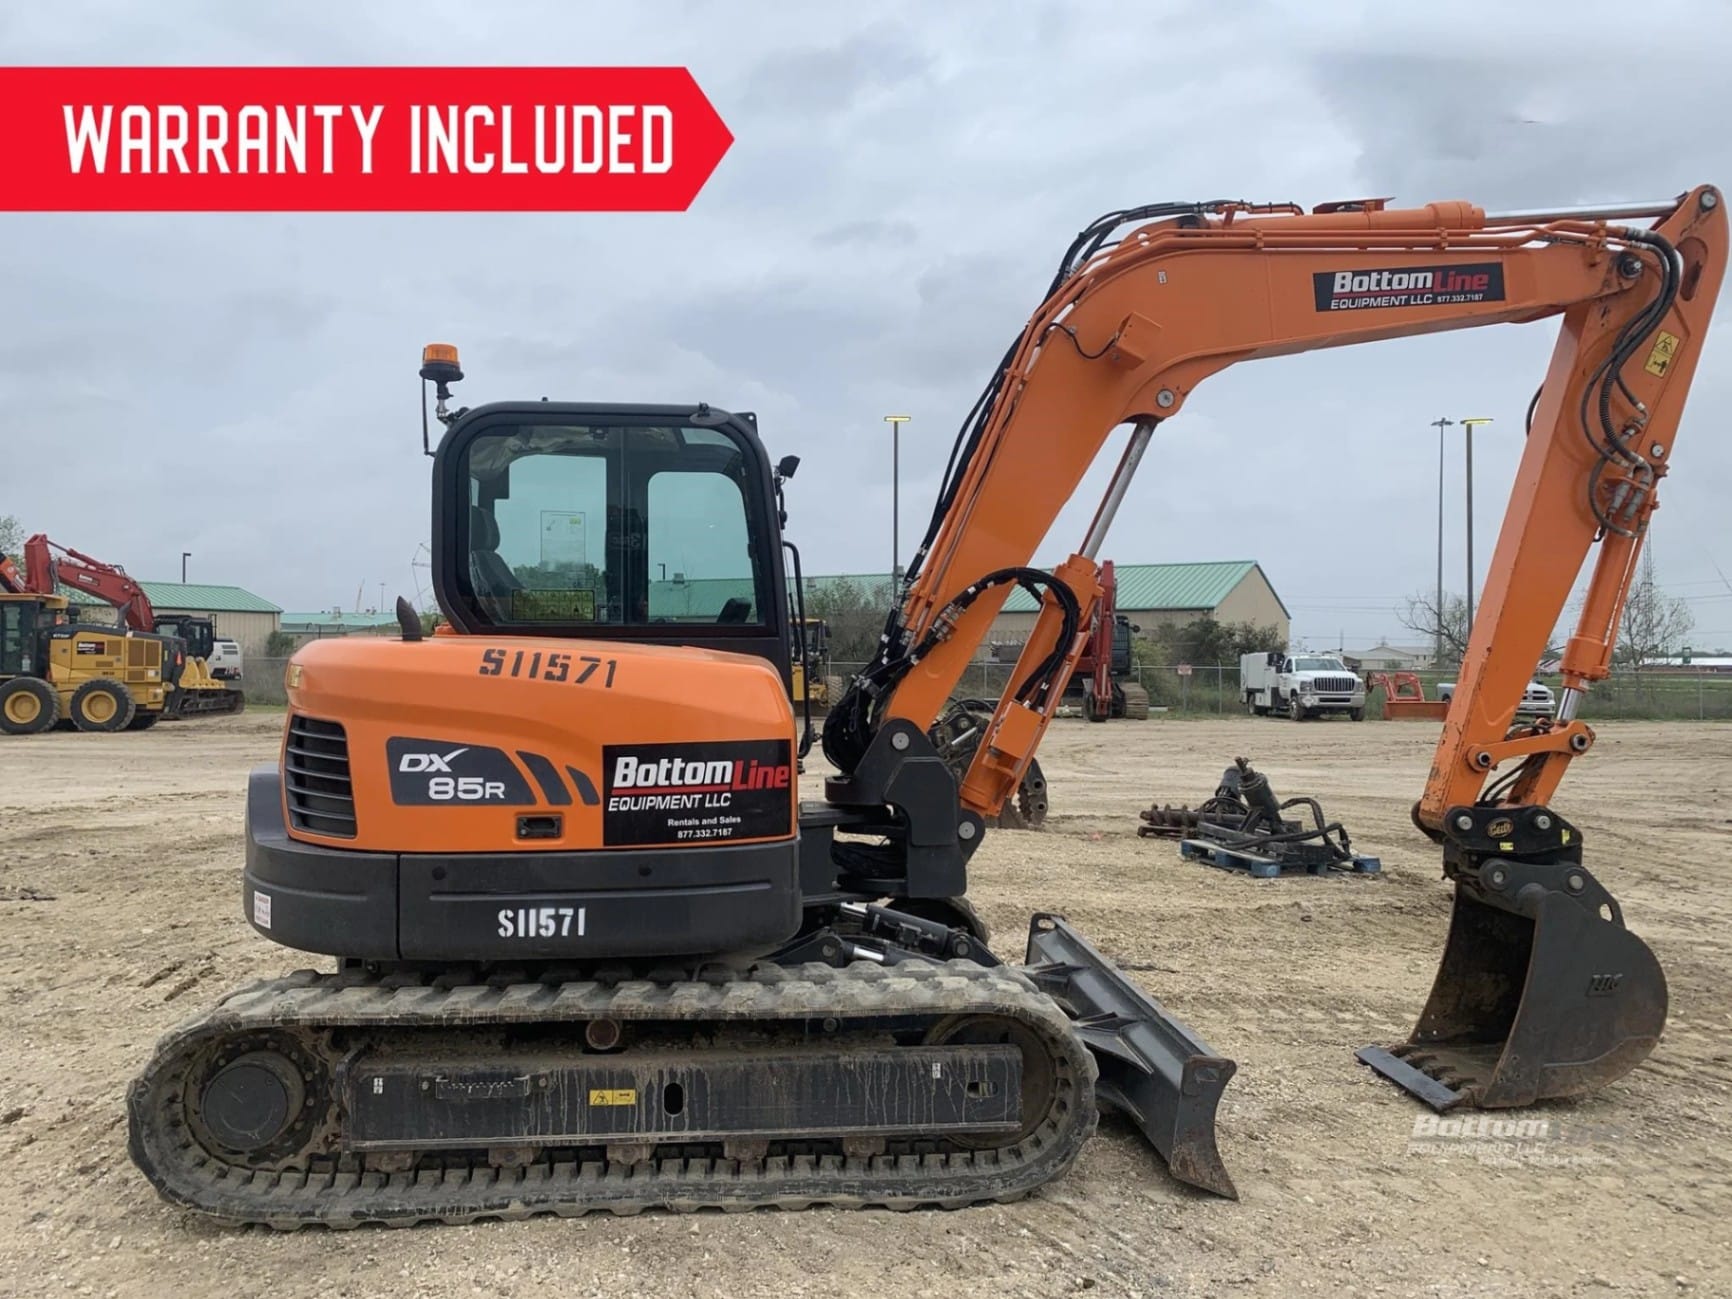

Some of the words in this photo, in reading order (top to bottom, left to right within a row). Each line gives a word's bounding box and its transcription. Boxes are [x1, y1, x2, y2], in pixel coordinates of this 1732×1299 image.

[1330, 294, 1406, 310] EQUIPMENT
[1409, 293, 1433, 305] LLC
[479, 648, 618, 688] S11571
[399, 748, 470, 772] DX
[428, 777, 505, 800] 85R
[608, 794, 702, 812] EQUIPMENT
[704, 793, 732, 807] LLC
[667, 817, 700, 827] Rentals
[701, 816, 718, 825] and
[719, 815, 742, 825] Sales
[677, 827, 733, 839] 877.332.7187
[497, 907, 586, 937] S11571
